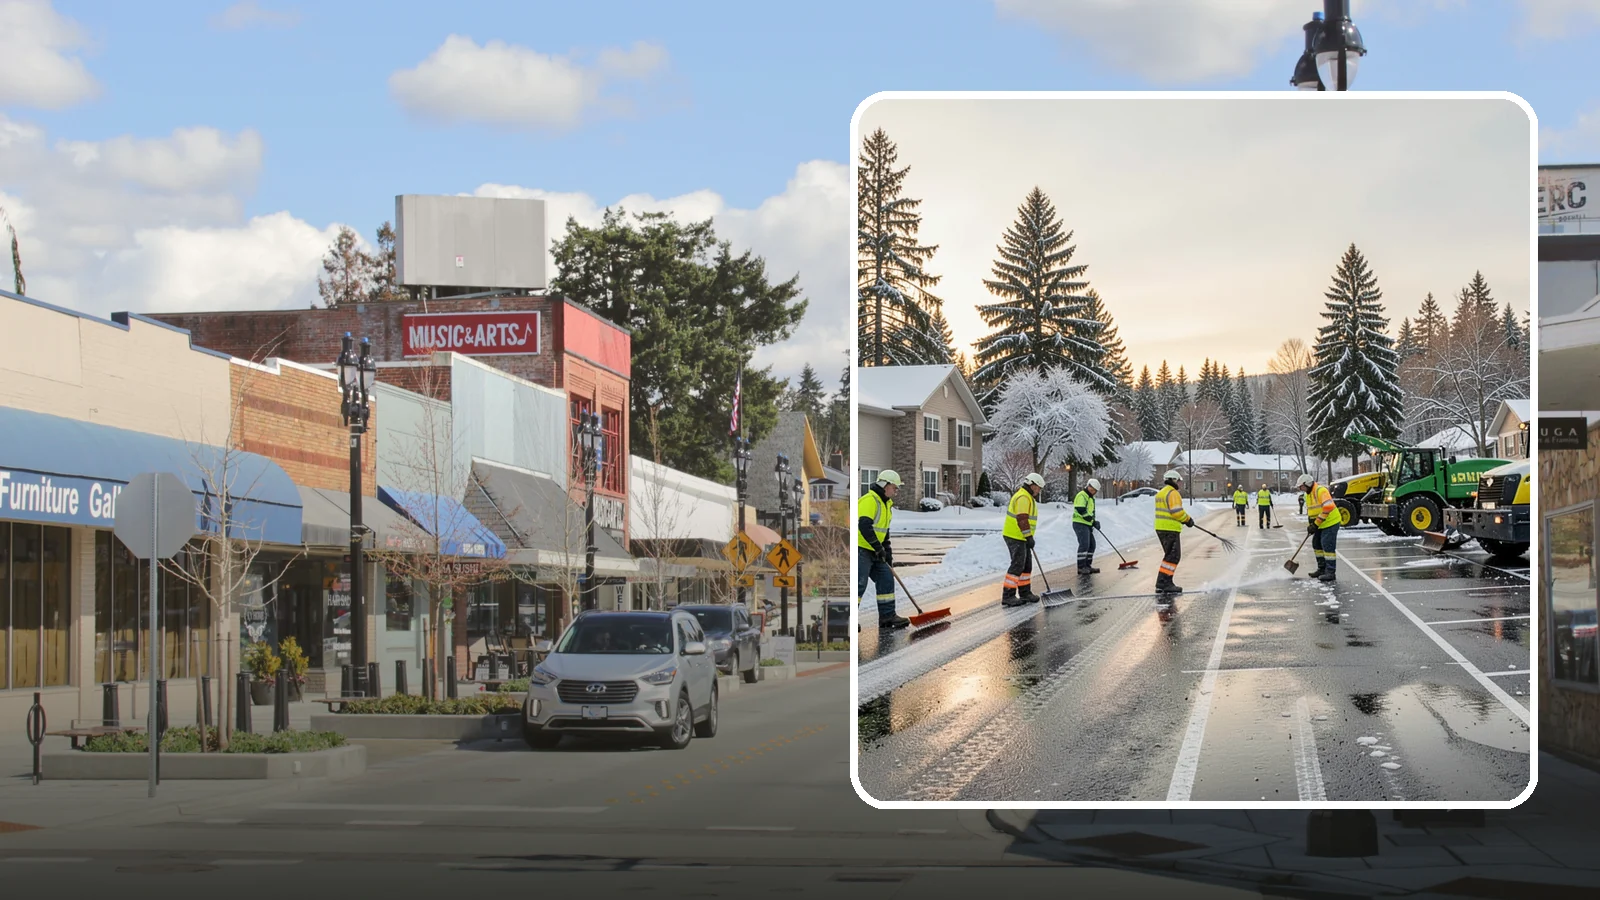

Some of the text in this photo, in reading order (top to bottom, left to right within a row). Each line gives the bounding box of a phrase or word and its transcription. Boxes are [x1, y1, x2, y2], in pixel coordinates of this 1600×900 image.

[1540, 428, 1577, 436] UGA
[0, 472, 79, 515] Furniture
[453, 562, 479, 574] SUSHI
